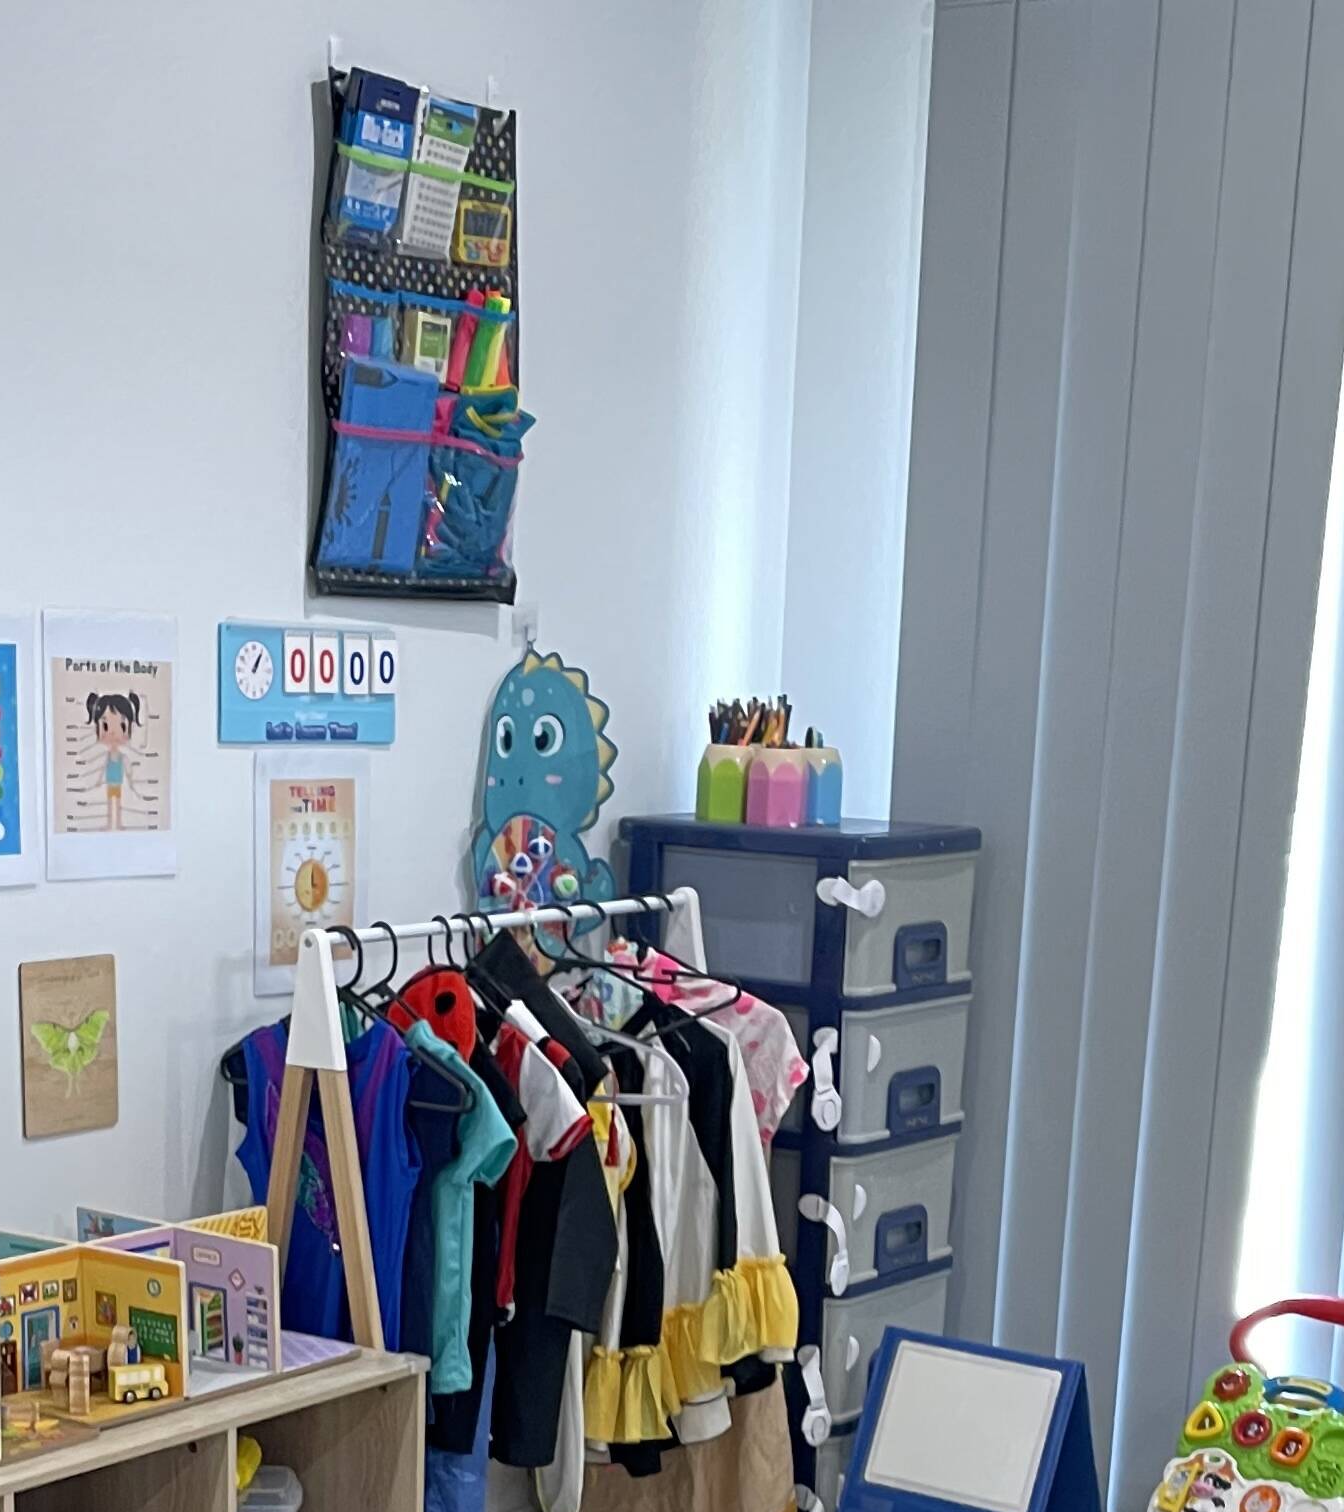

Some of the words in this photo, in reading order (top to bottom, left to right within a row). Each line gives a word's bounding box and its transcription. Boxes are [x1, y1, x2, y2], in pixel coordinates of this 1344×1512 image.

[290, 648, 306, 684] 0
[319, 649, 335, 684] 0
[349, 651, 365, 686] 0
[379, 650, 395, 684] 0
